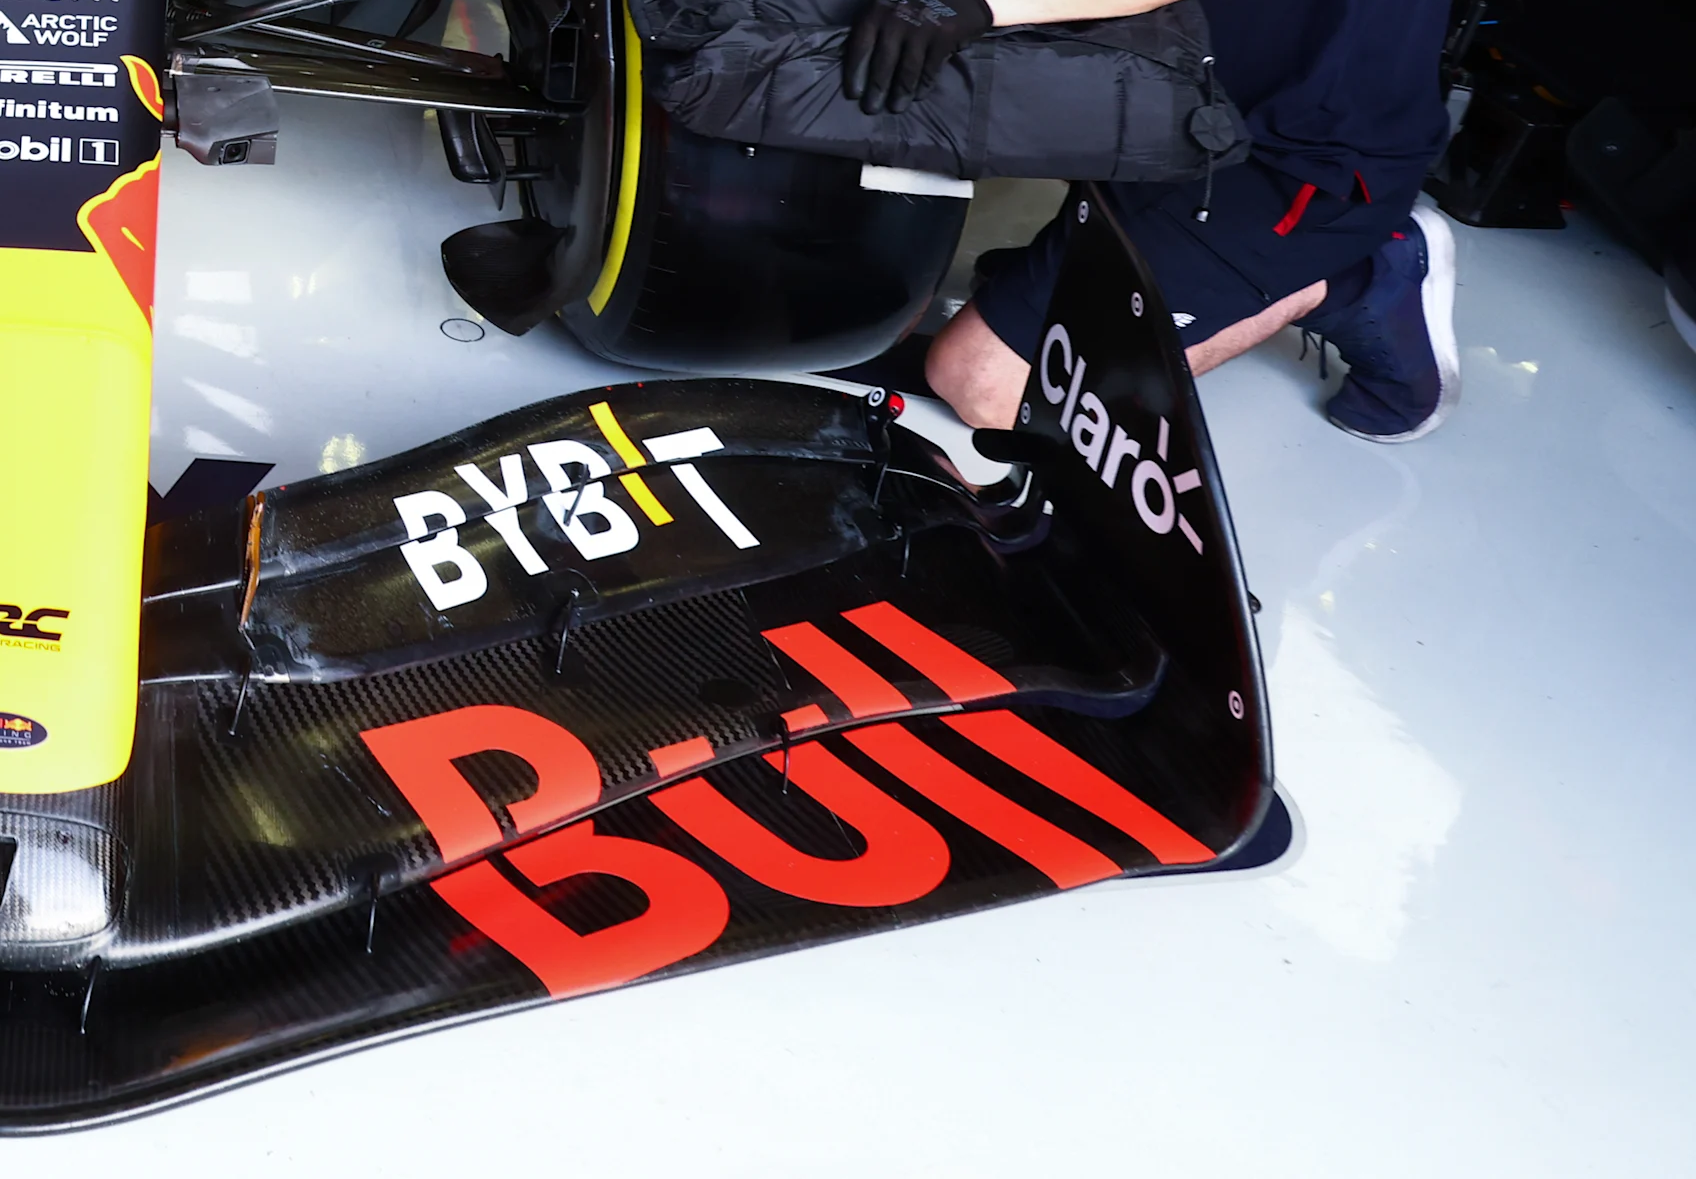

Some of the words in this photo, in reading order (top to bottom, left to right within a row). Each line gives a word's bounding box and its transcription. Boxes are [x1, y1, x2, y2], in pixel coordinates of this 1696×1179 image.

[21, 14, 118, 32] ARCTIC
[34, 30, 109, 48] WOLF
[394, 402, 761, 612] BYBIT
[1040, 324, 1189, 542] Claro
[360, 602, 1217, 1000] Bull
